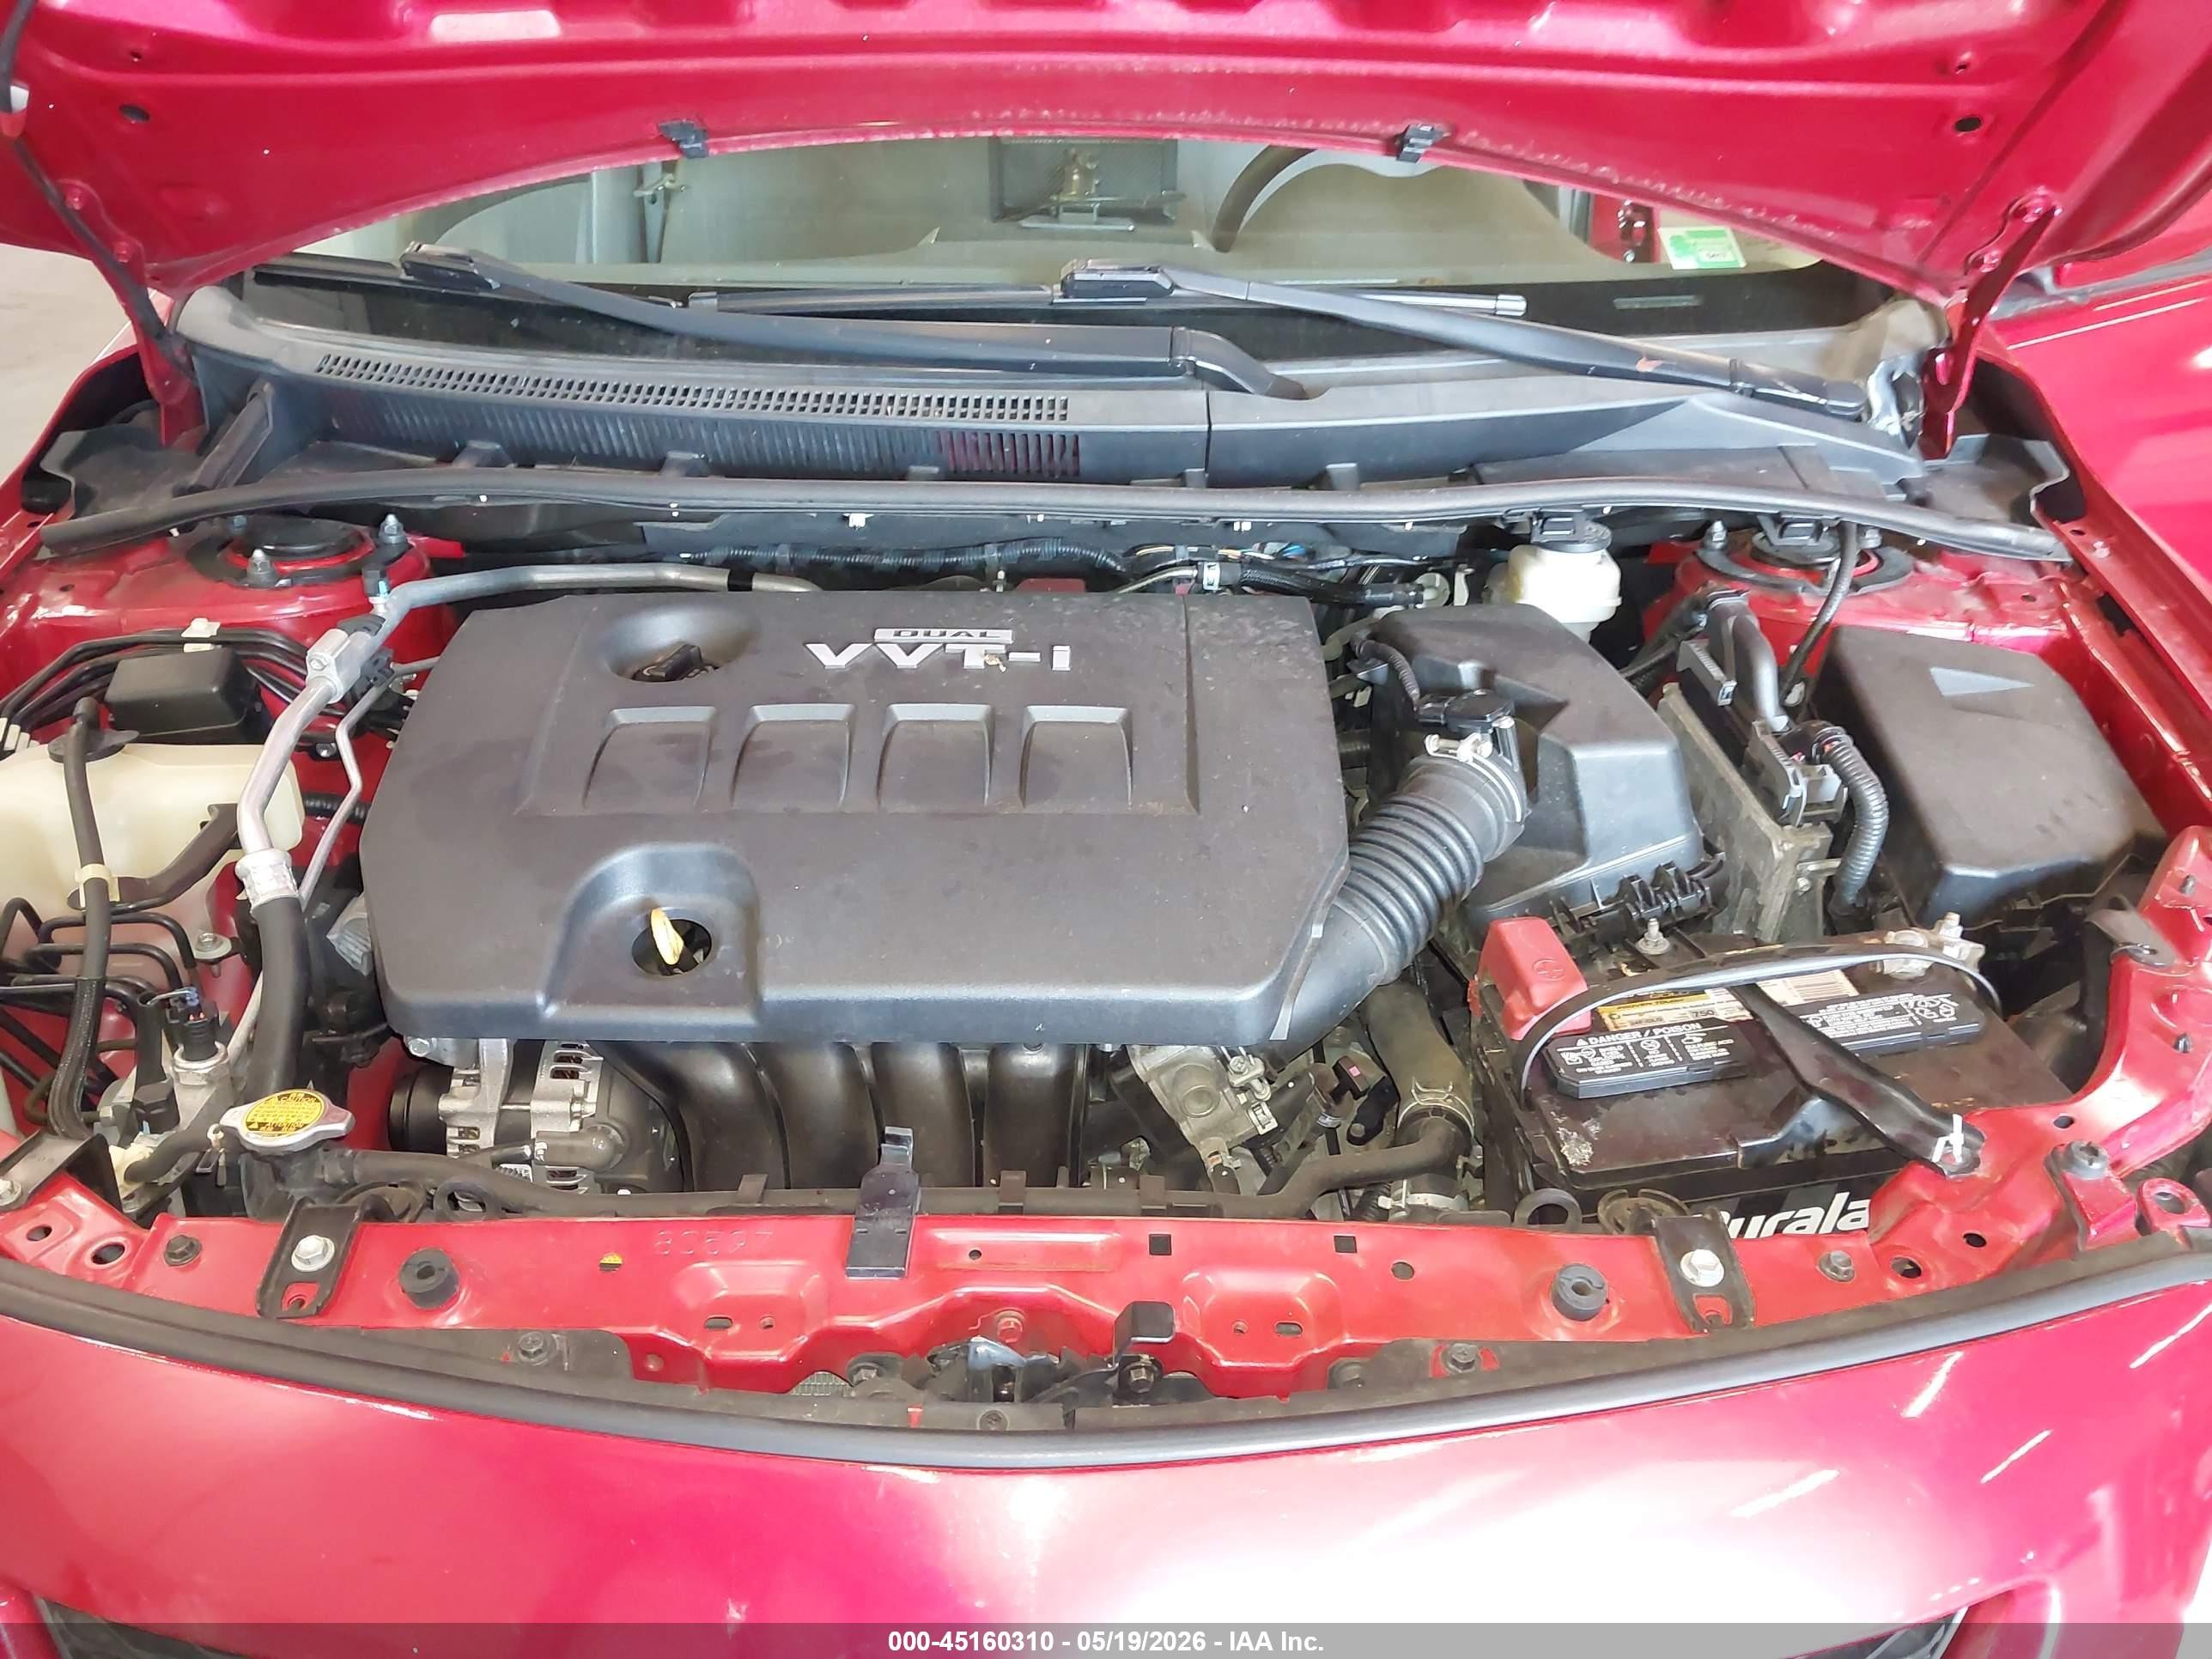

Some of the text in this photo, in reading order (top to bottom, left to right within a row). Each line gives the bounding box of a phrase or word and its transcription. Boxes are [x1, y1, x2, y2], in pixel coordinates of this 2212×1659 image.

[891, 629, 1003, 640] DUAL
[1691, 1009, 1716, 1018] 750
[1589, 1030, 1643, 1046] DANGER
[1655, 1022, 1702, 1036] POISON
